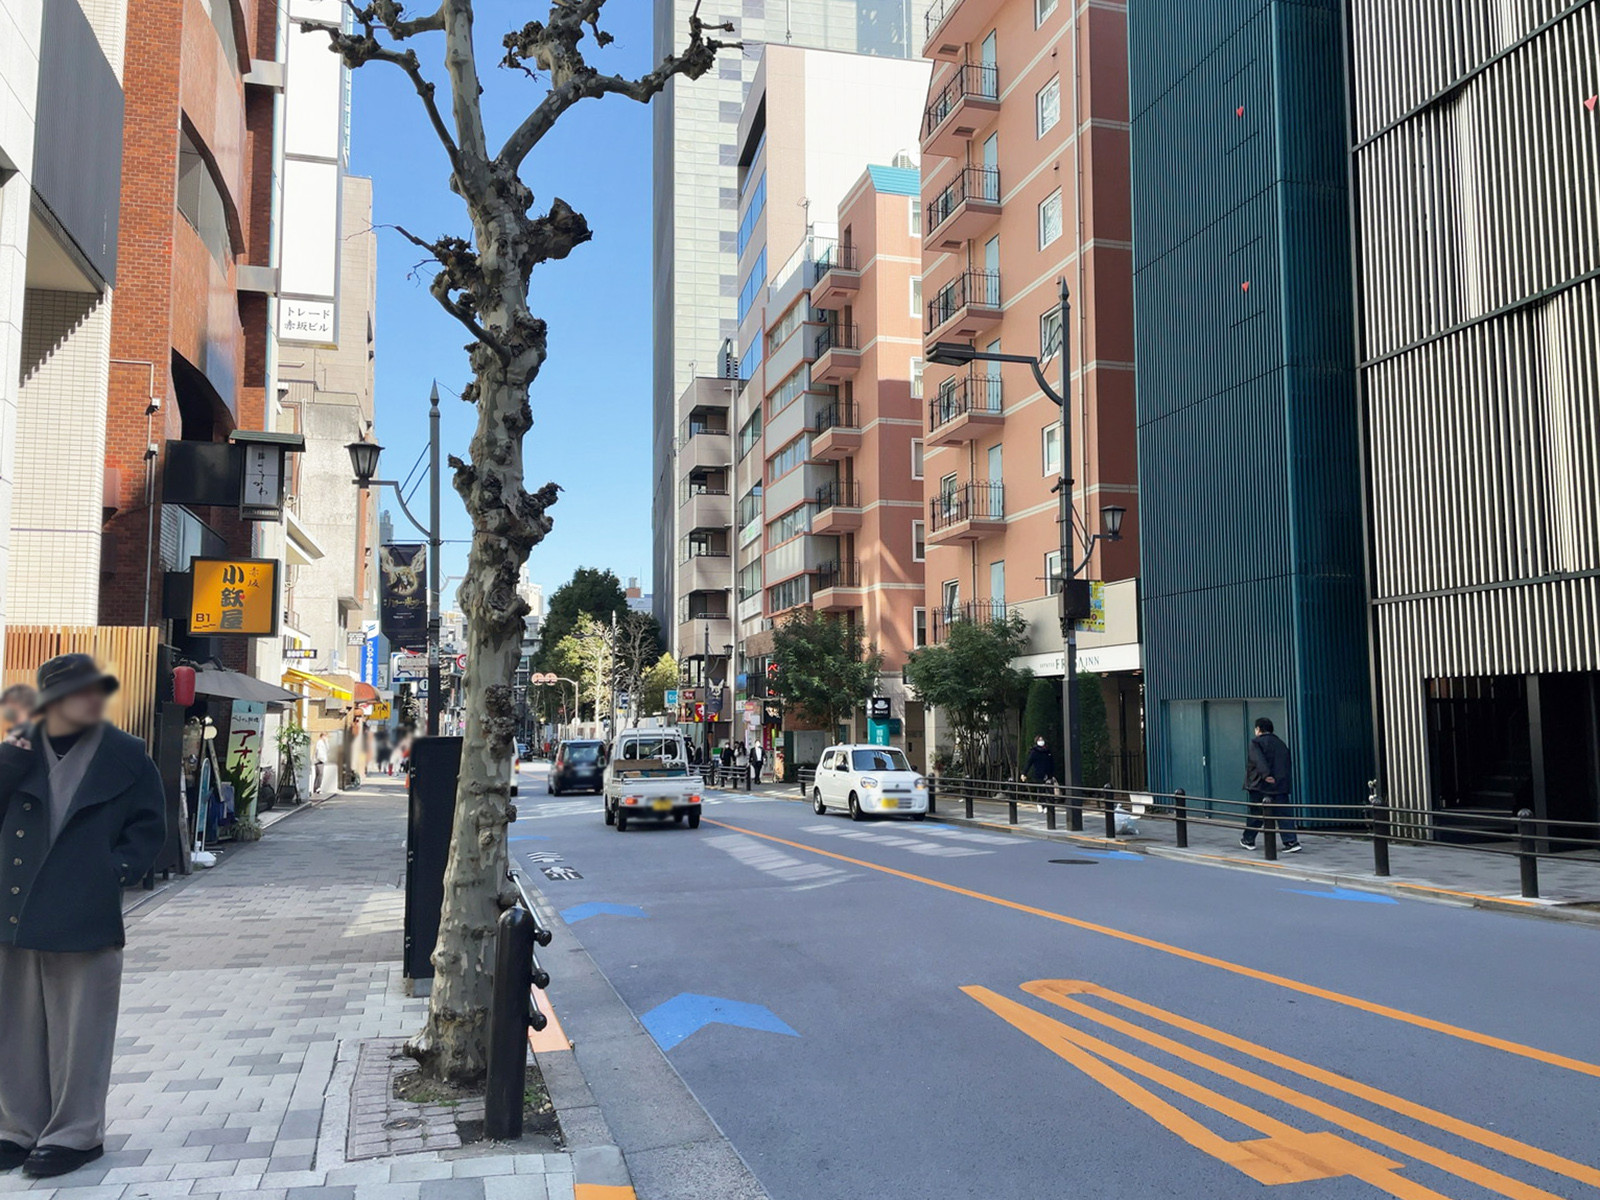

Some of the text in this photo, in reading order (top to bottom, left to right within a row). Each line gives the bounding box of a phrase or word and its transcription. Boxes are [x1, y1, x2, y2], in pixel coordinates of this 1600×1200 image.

[287, 306, 331, 320] トレード
[284, 319, 329, 332] 赤坂ビル
[195, 613, 211, 623] B1
